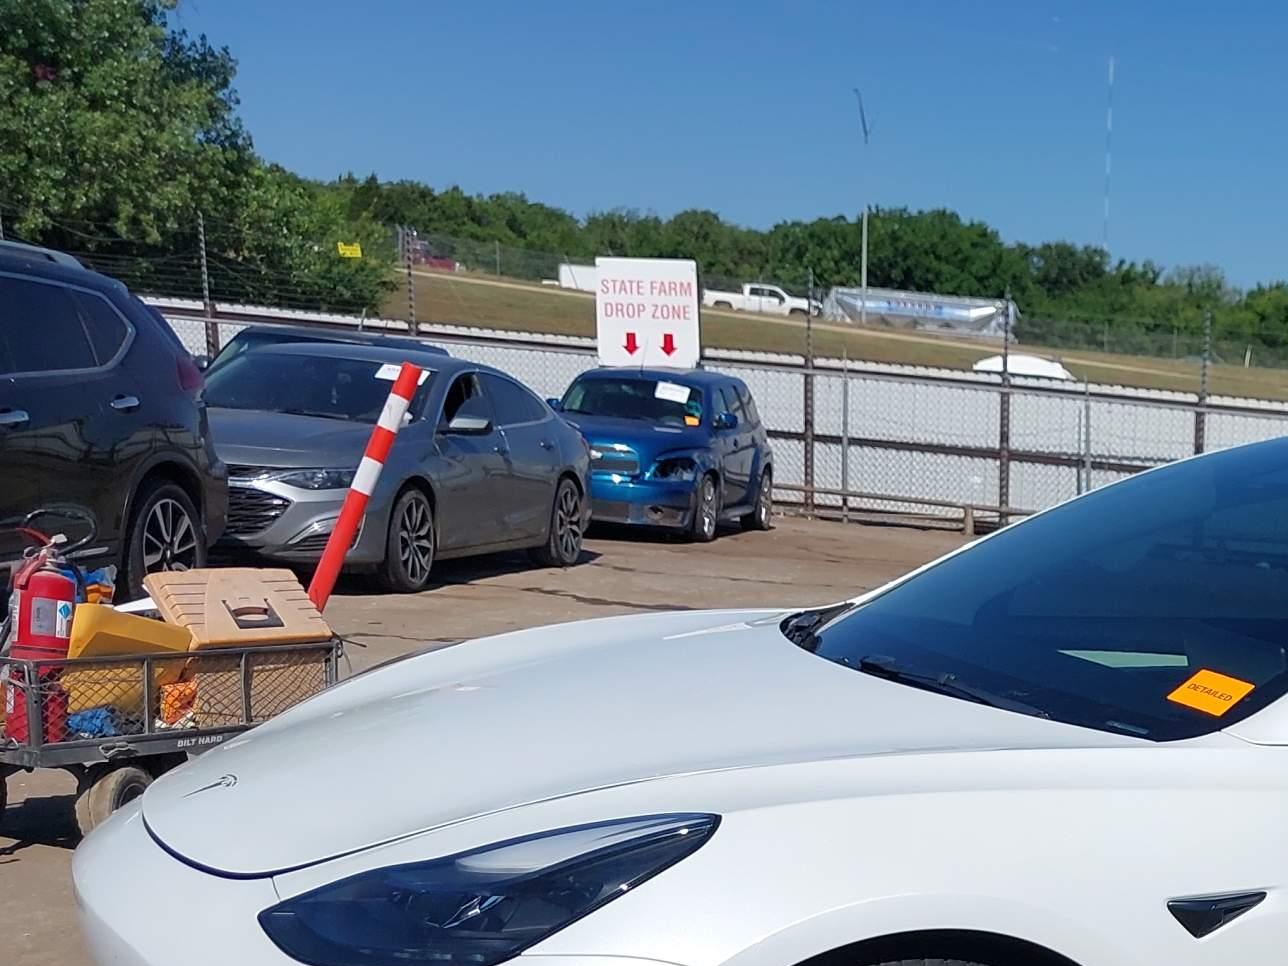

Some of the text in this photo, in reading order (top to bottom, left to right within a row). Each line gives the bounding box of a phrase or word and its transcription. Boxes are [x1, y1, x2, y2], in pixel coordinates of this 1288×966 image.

[601, 279, 693, 297] STATE FARM
[604, 302, 691, 320] DROP ZONE
[1187, 682, 1233, 702] DETAILED
